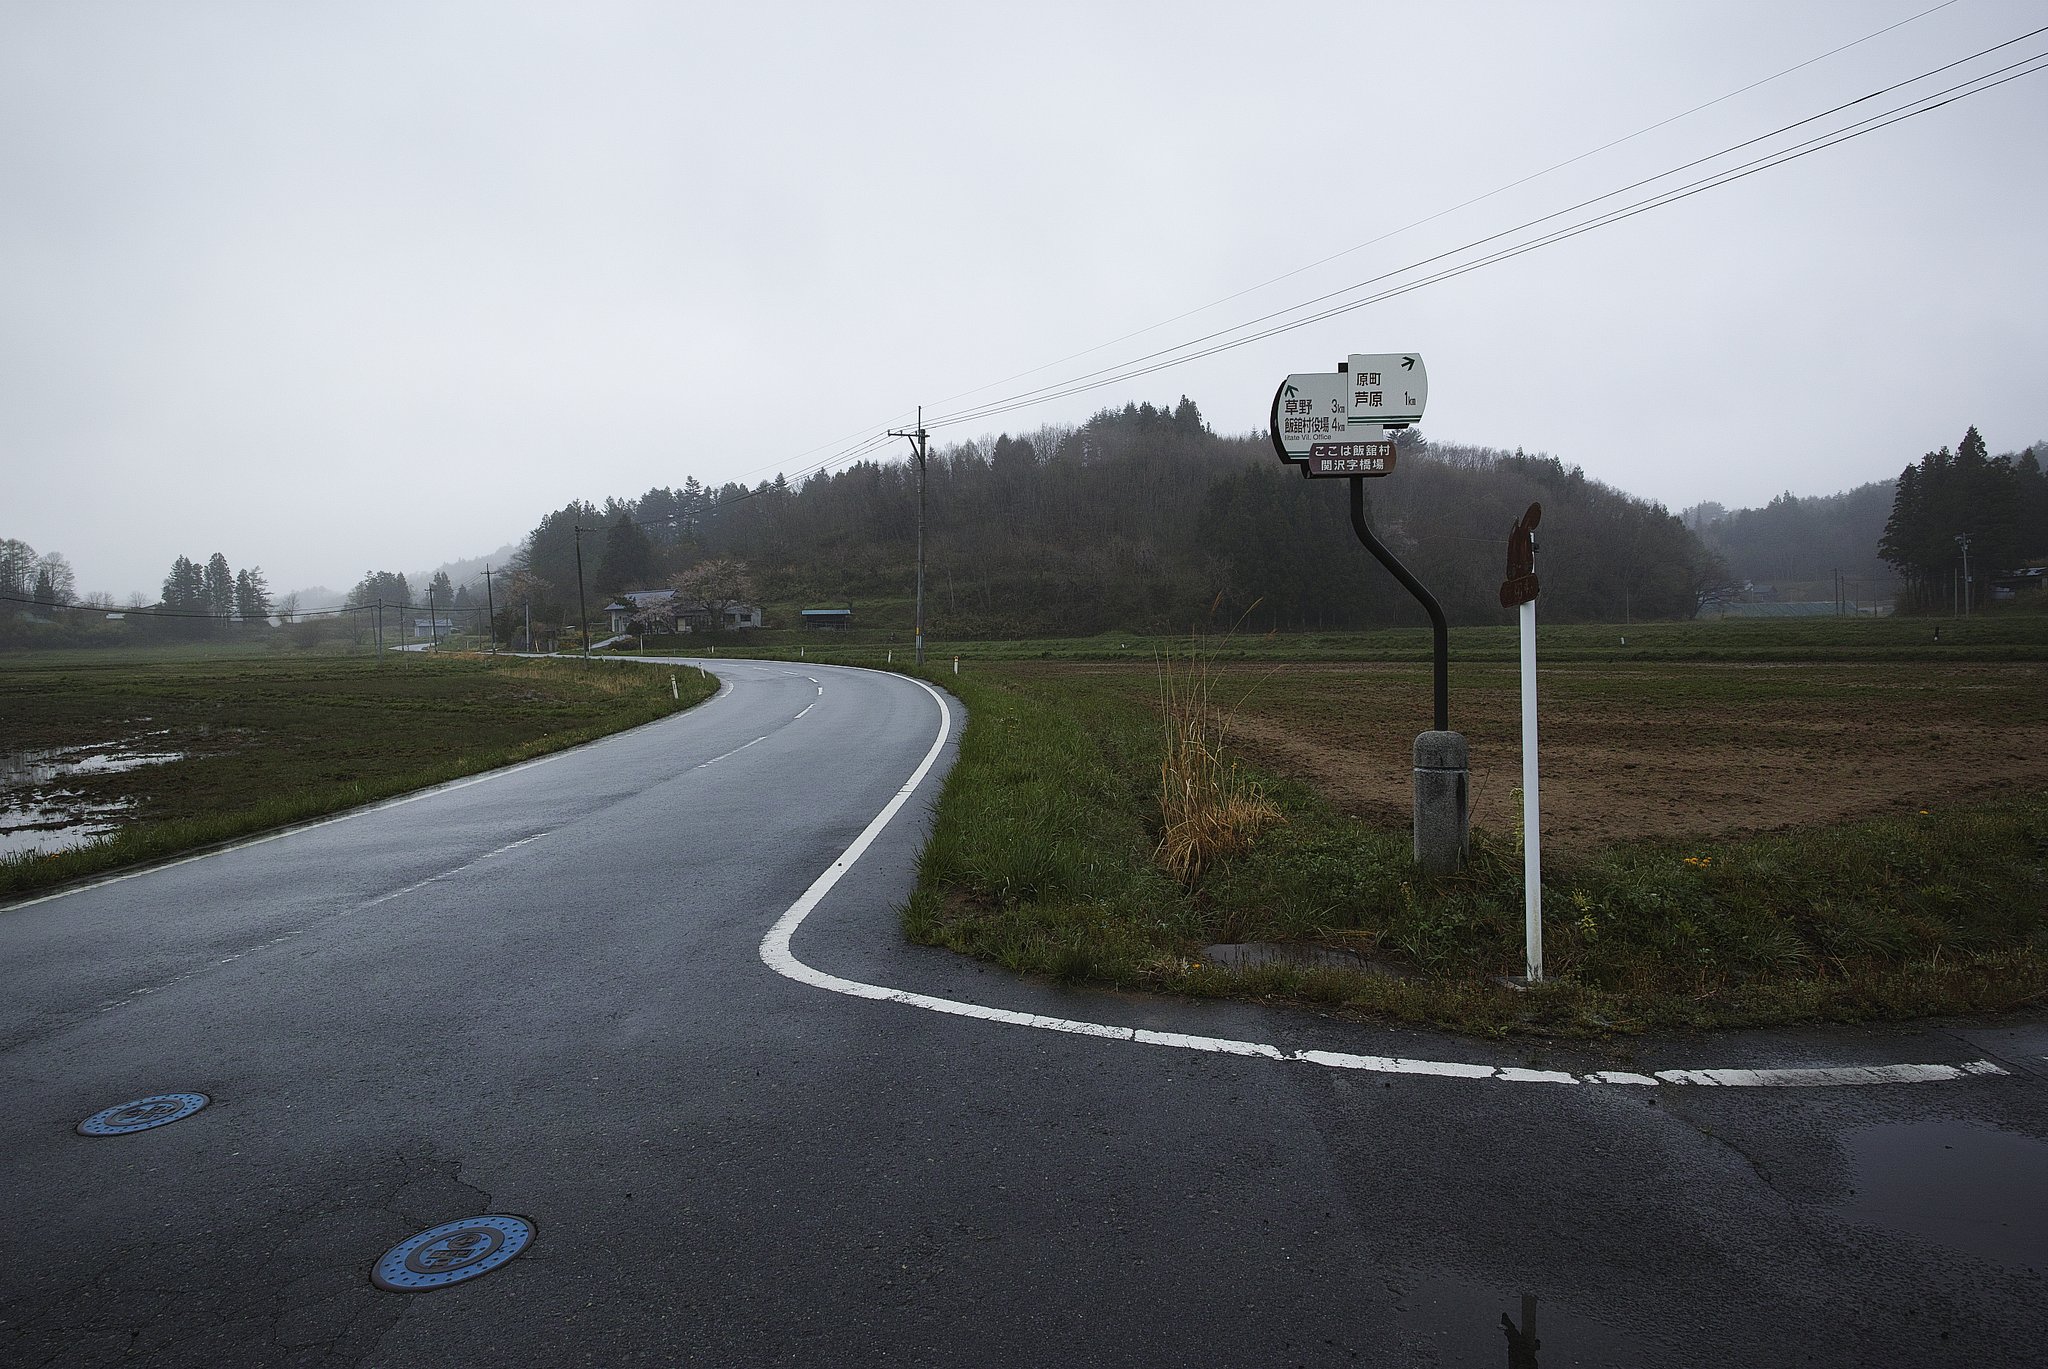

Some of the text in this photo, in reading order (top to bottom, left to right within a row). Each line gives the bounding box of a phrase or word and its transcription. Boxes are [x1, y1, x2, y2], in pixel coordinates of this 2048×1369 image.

[1356, 372, 1381, 386] 原町
[1285, 399, 1312, 415] 草野
[1355, 391, 1382, 407] 芦原
